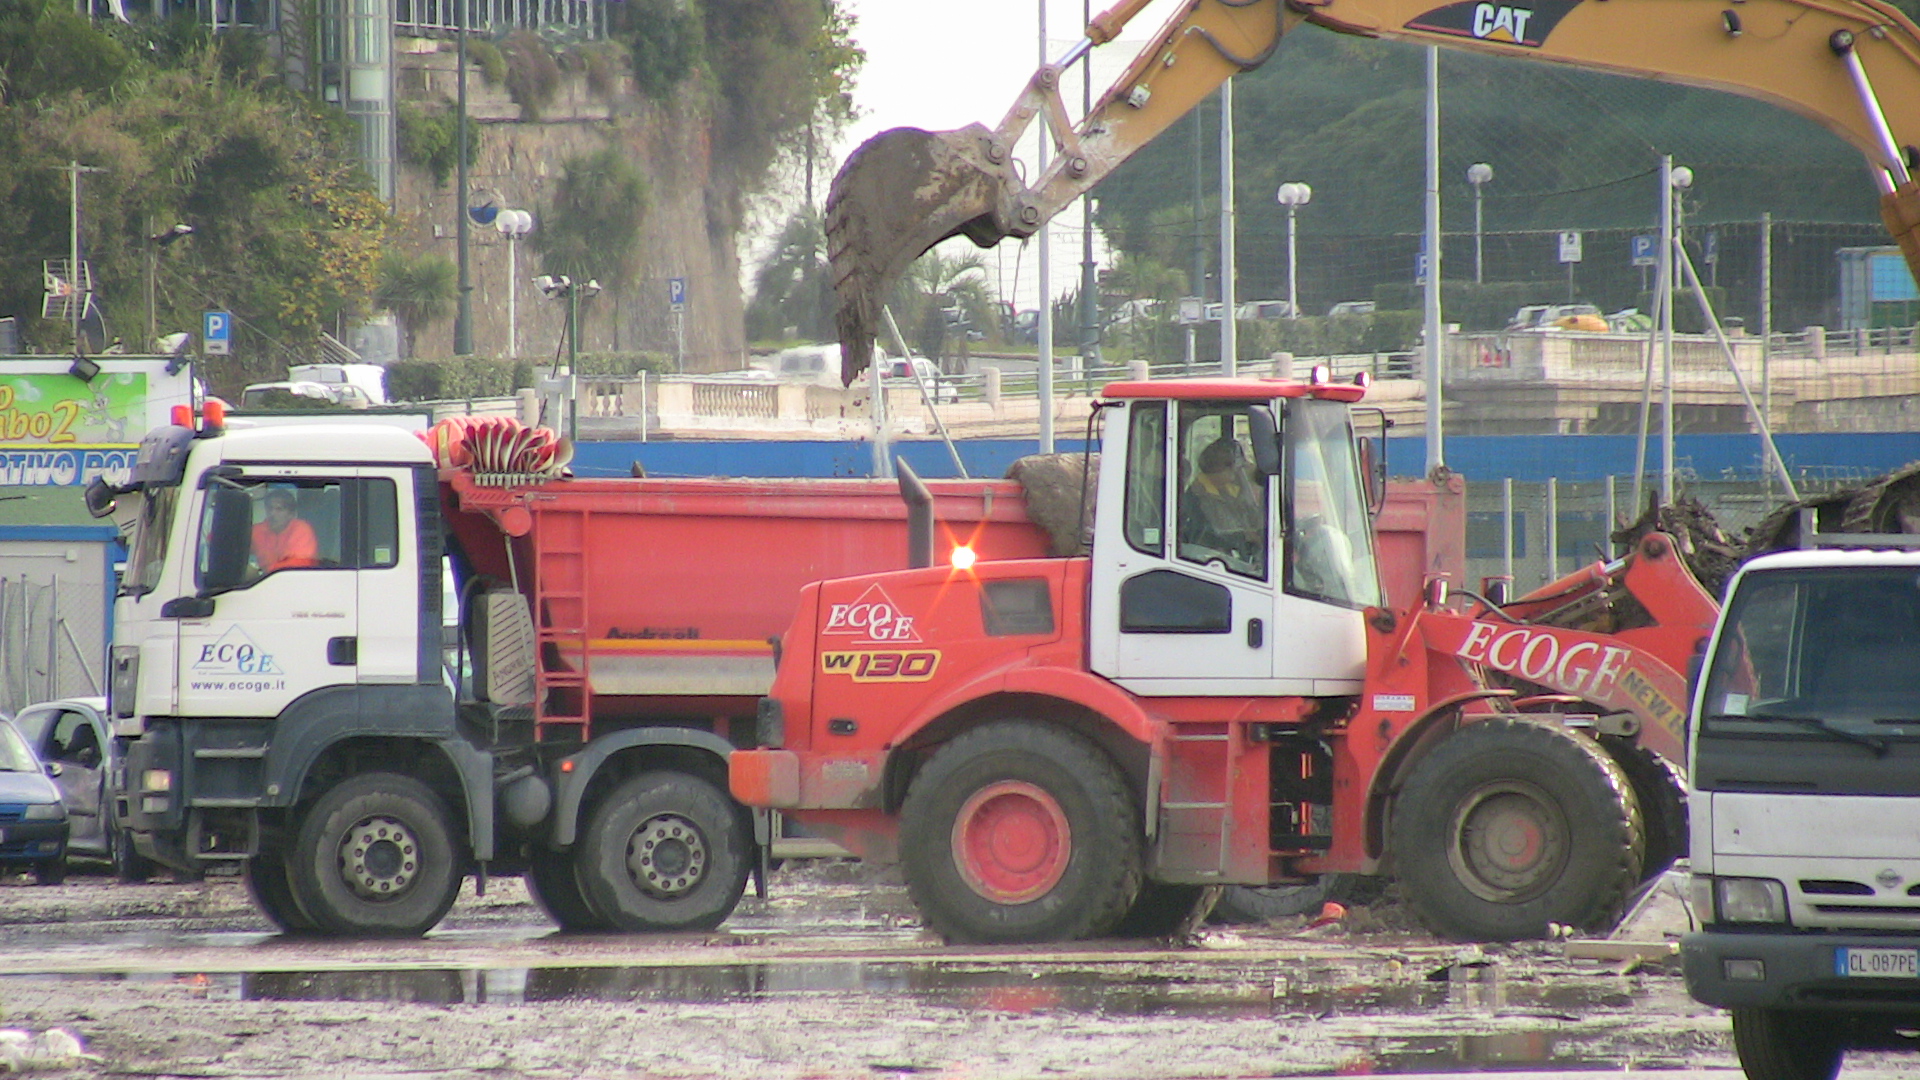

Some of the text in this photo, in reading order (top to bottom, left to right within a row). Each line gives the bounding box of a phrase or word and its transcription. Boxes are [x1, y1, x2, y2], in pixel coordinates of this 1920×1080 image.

[1473, 3, 1534, 43] CAT
[1637, 238, 1651, 256] P
[671, 281, 682, 301] P
[209, 315, 223, 337] P
[190, 680, 286, 692] www.ecoge.it
[1621, 671, 1673, 719] NEW
